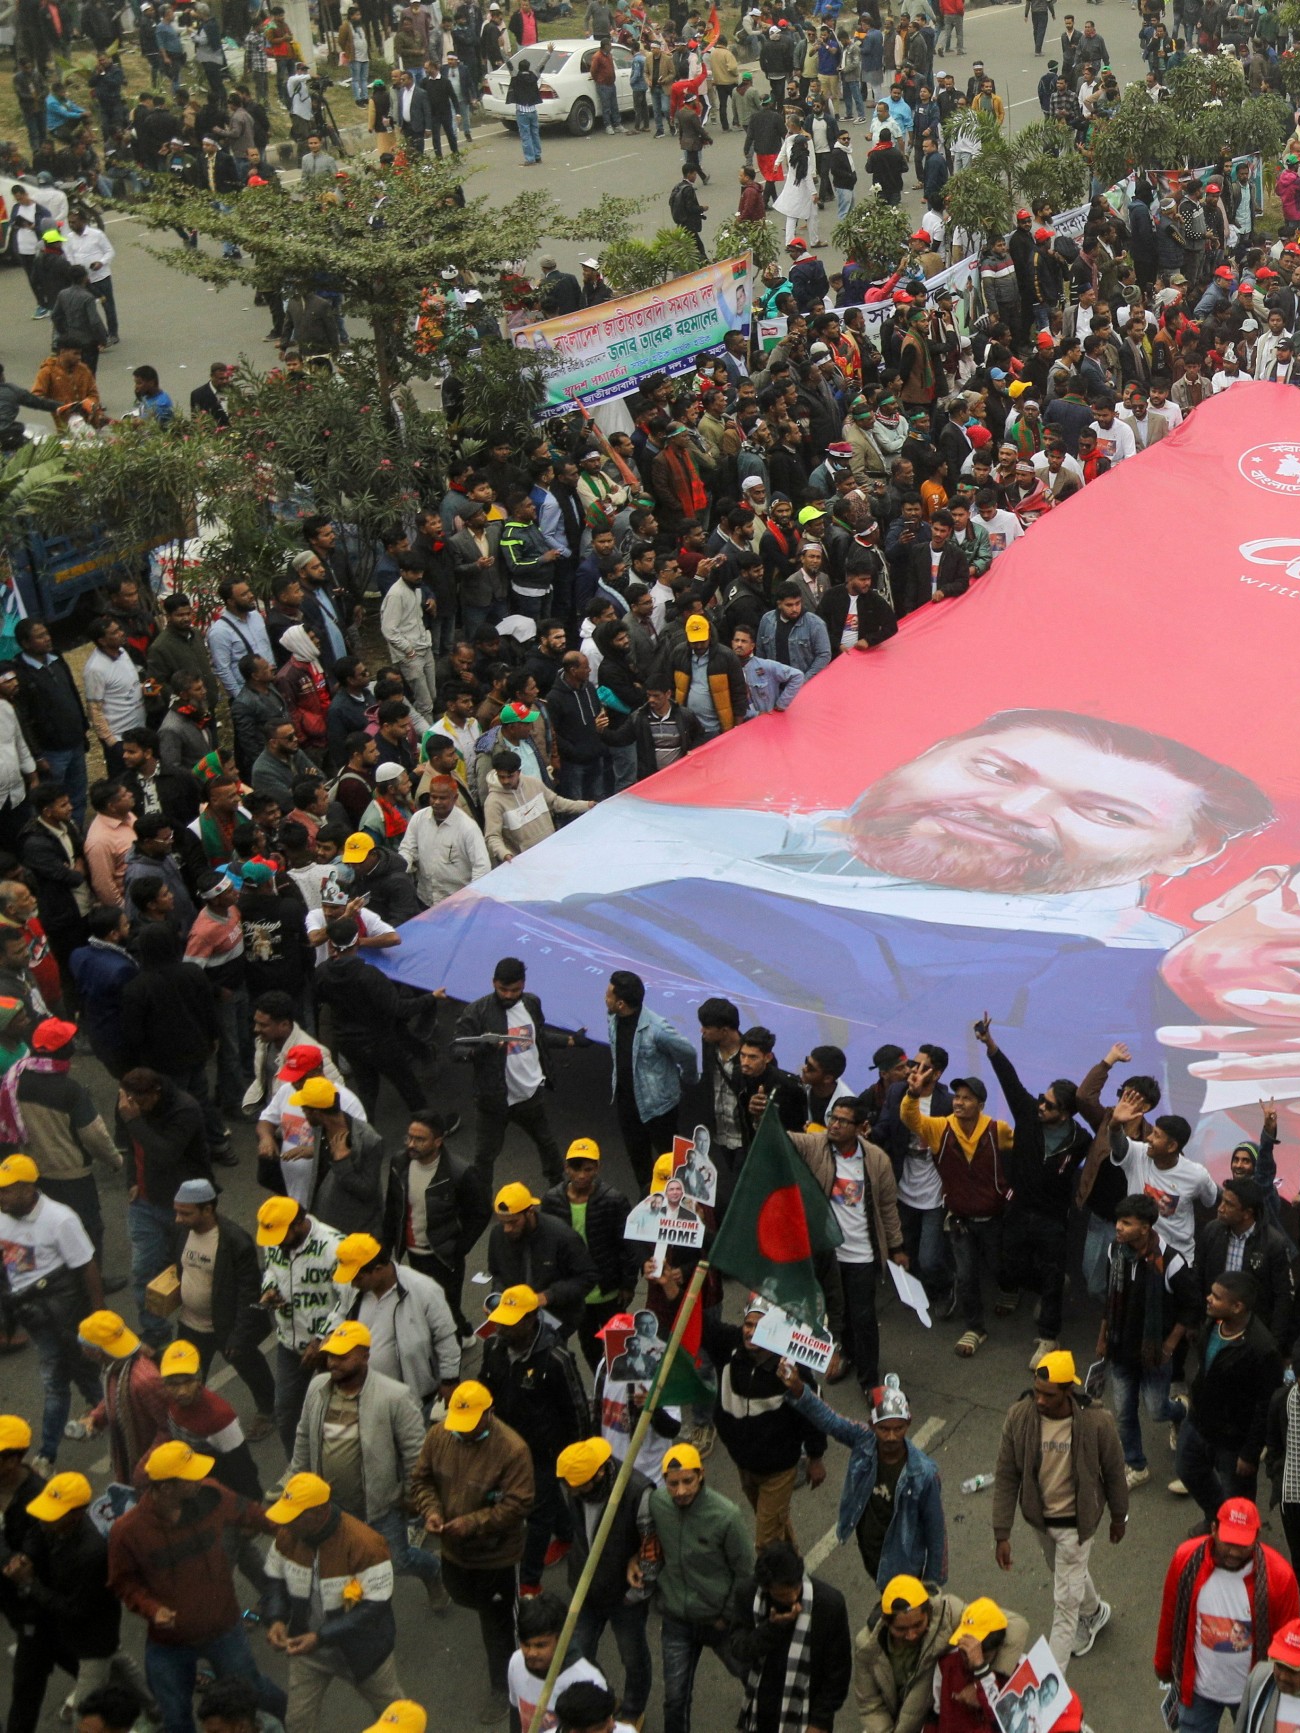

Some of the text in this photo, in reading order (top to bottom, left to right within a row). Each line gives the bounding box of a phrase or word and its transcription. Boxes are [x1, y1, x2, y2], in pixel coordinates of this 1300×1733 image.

[659, 1218, 699, 1230] WELCOME
[657, 1228, 697, 1245] HOME
[792, 1330, 832, 1353] WELCOME
[786, 1340, 828, 1368] HOME
